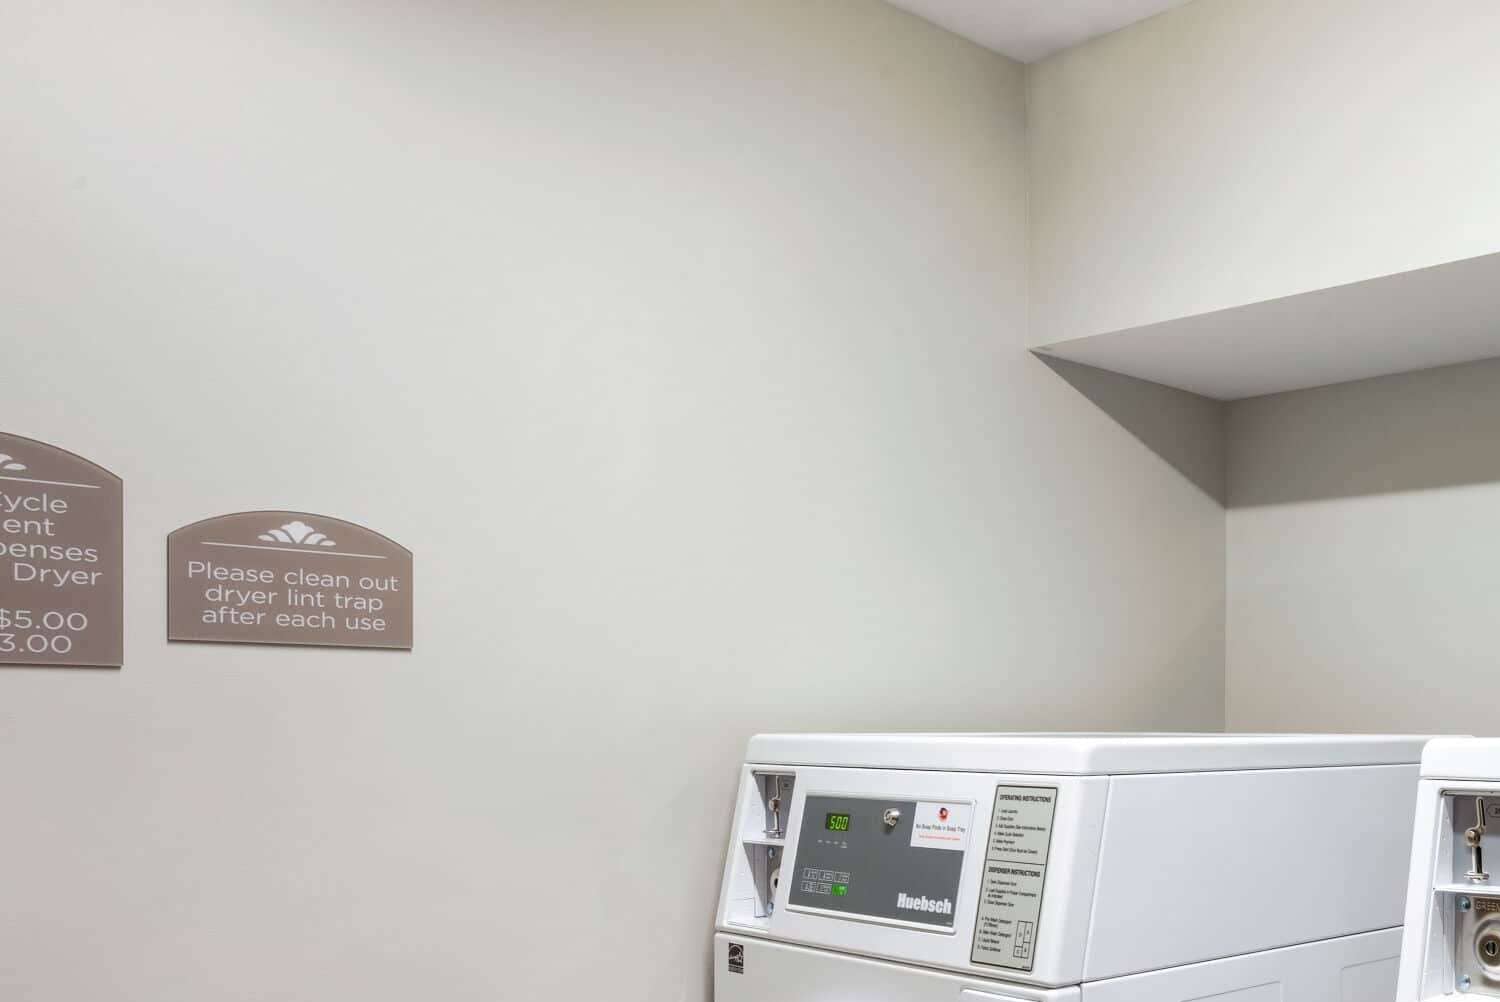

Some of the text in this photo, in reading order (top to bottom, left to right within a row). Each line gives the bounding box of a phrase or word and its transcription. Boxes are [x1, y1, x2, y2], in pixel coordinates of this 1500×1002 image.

[0, 491, 69, 514] ycle
[13, 562, 104, 588] Dryer
[187, 560, 400, 592] Please clean out
[204, 584, 384, 613] dryer lint trap
[0, 608, 89, 631] $5.00
[201, 606, 387, 632] after each use
[0, 633, 73, 654] 3.00
[829, 815, 849, 830] 500
[896, 892, 952, 914] Huebsch
